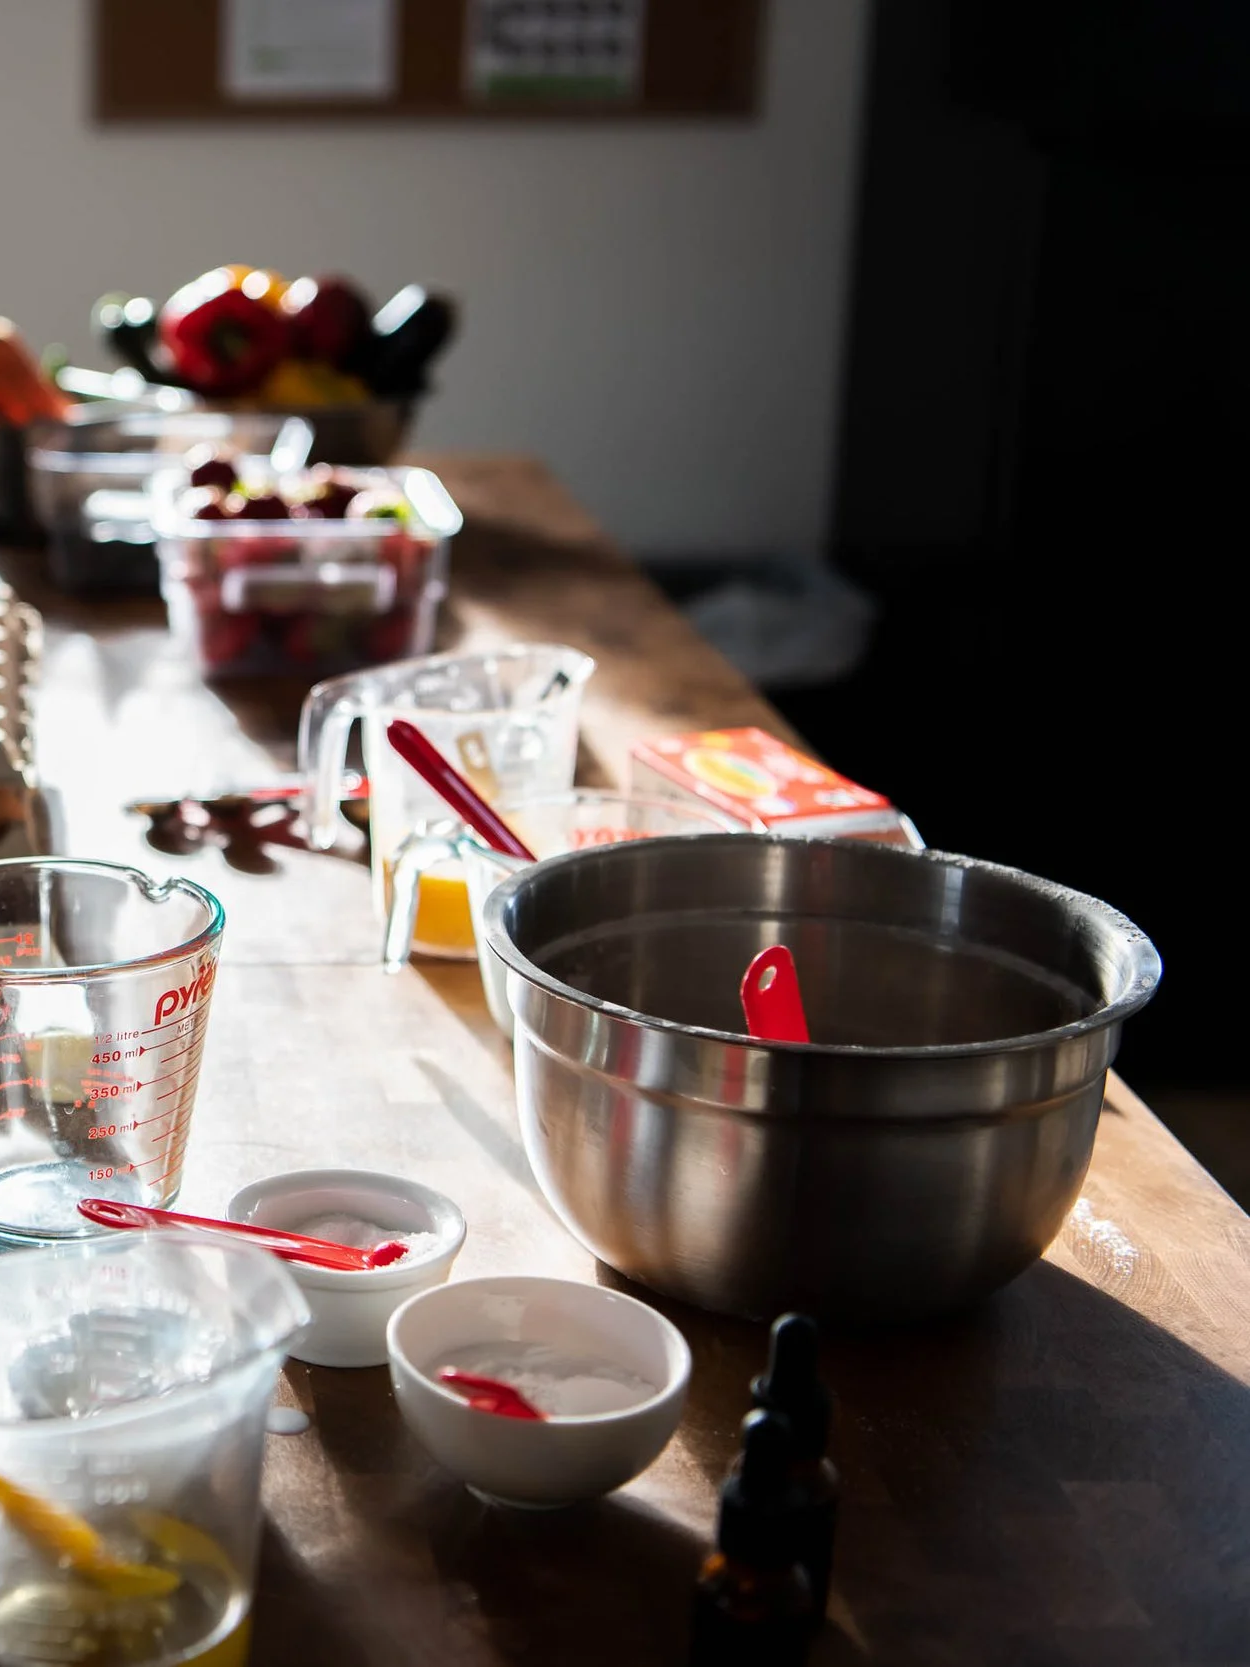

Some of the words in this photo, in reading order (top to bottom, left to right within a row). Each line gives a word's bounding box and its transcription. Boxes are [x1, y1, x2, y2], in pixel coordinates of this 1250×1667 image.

[95, 1034, 113, 1045] 1/2
[117, 1030, 140, 1041] litre
[92, 1050, 121, 1065] 450
[125, 1048, 139, 1059] ml
[91, 1085, 119, 1100] 350
[122, 1083, 136, 1094] ml
[89, 1125, 116, 1139] 250
[120, 1123, 132, 1133] ml
[89, 1168, 113, 1181] 150
